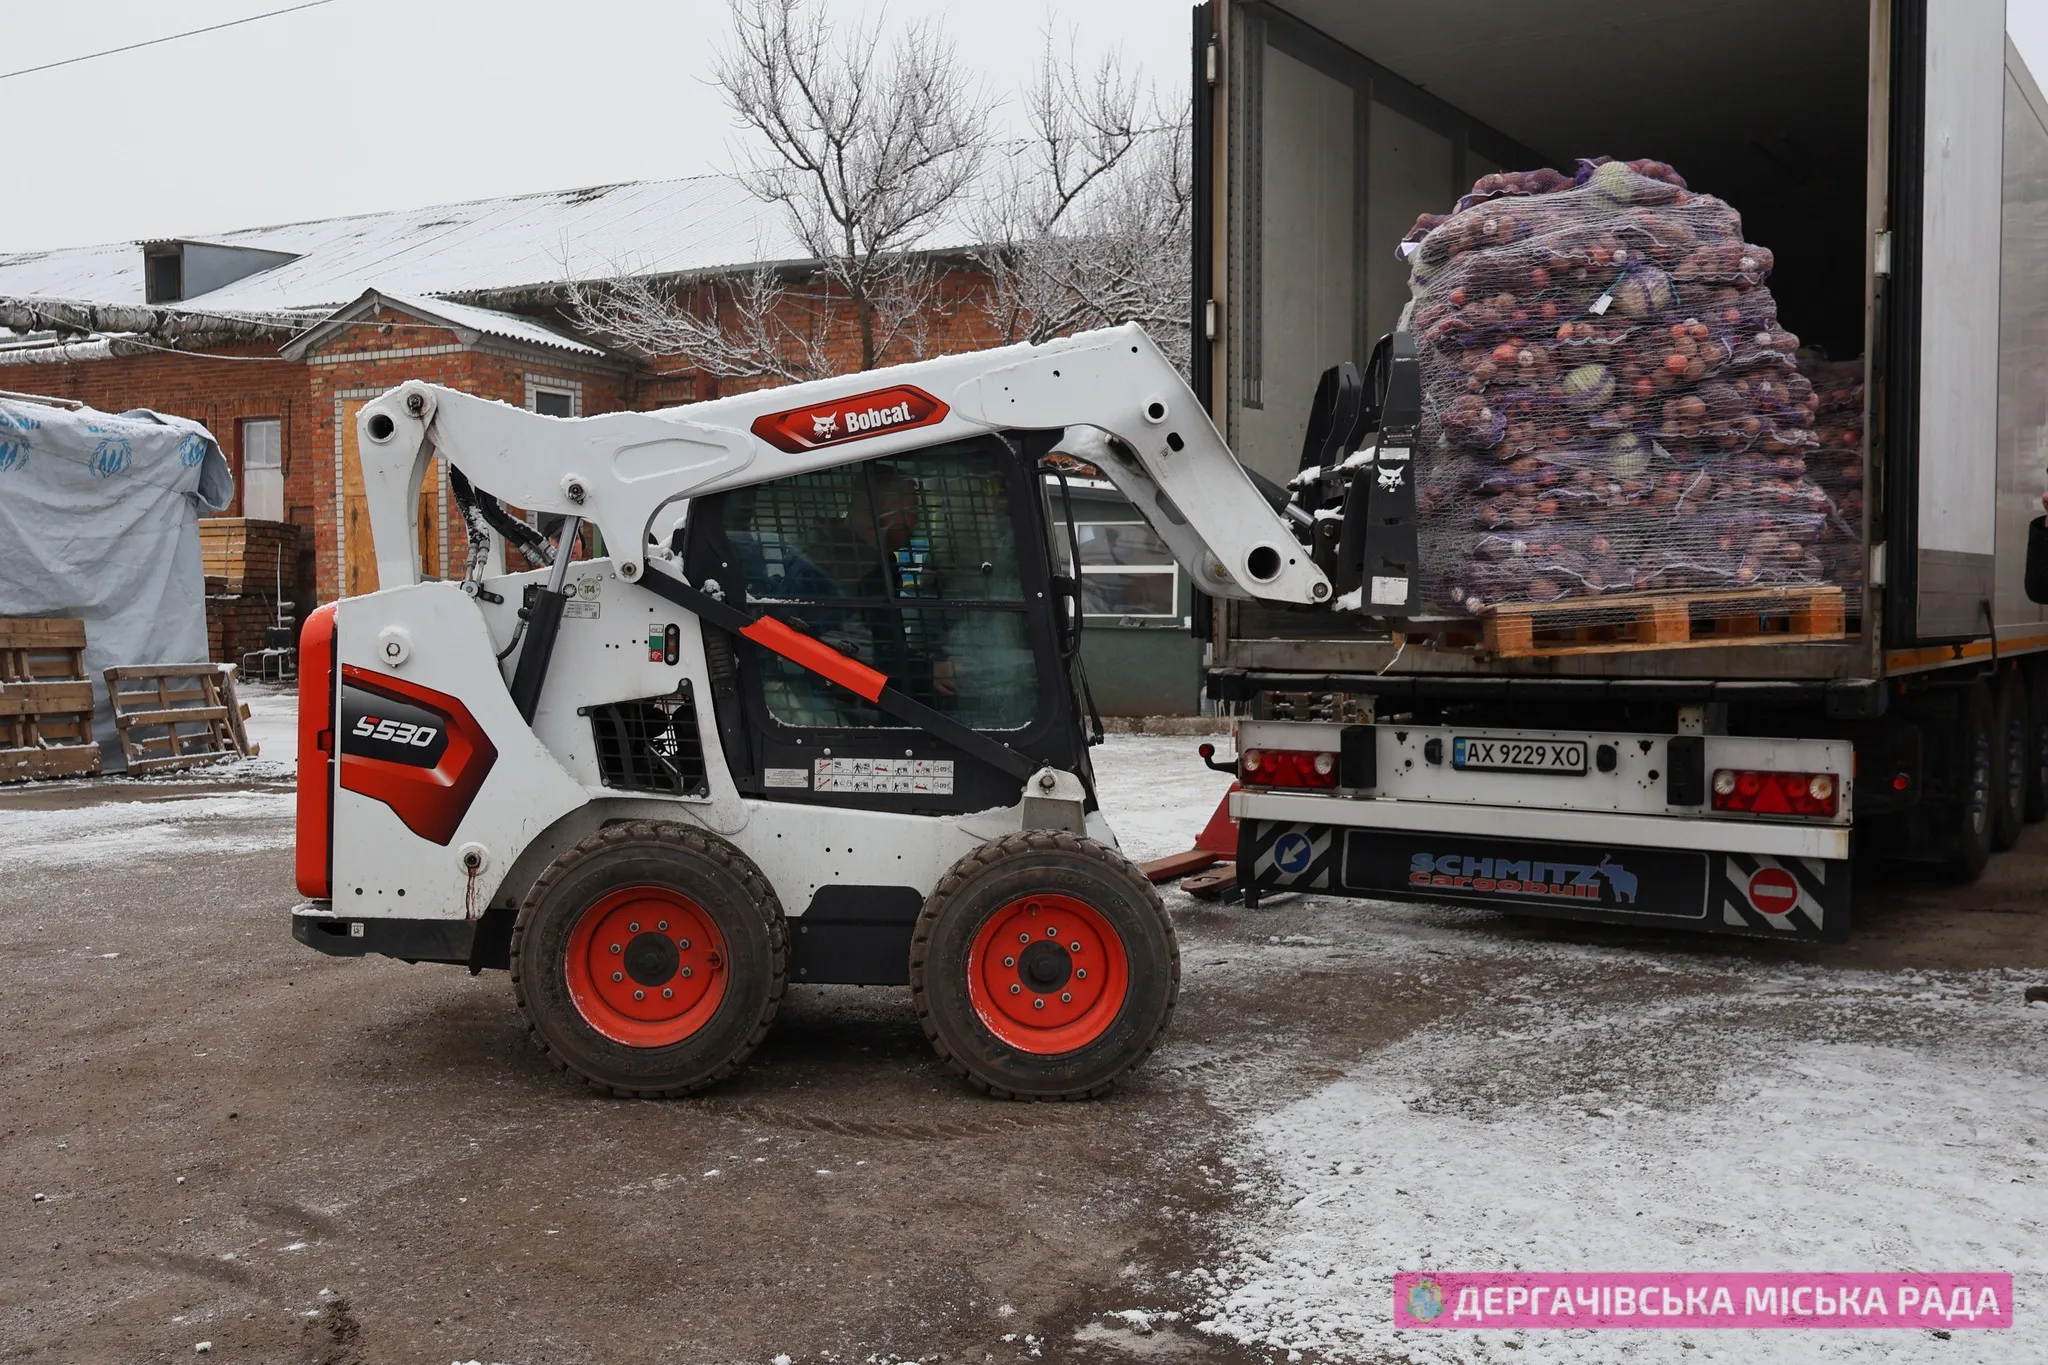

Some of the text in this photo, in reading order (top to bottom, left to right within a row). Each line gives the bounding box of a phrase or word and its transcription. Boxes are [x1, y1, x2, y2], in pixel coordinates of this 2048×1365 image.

[845, 401, 911, 433] Bobcat
[352, 715, 438, 747] S530
[1467, 743, 1580, 766] AX 9229 XO
[1410, 853, 1600, 885] SCHMITZ
